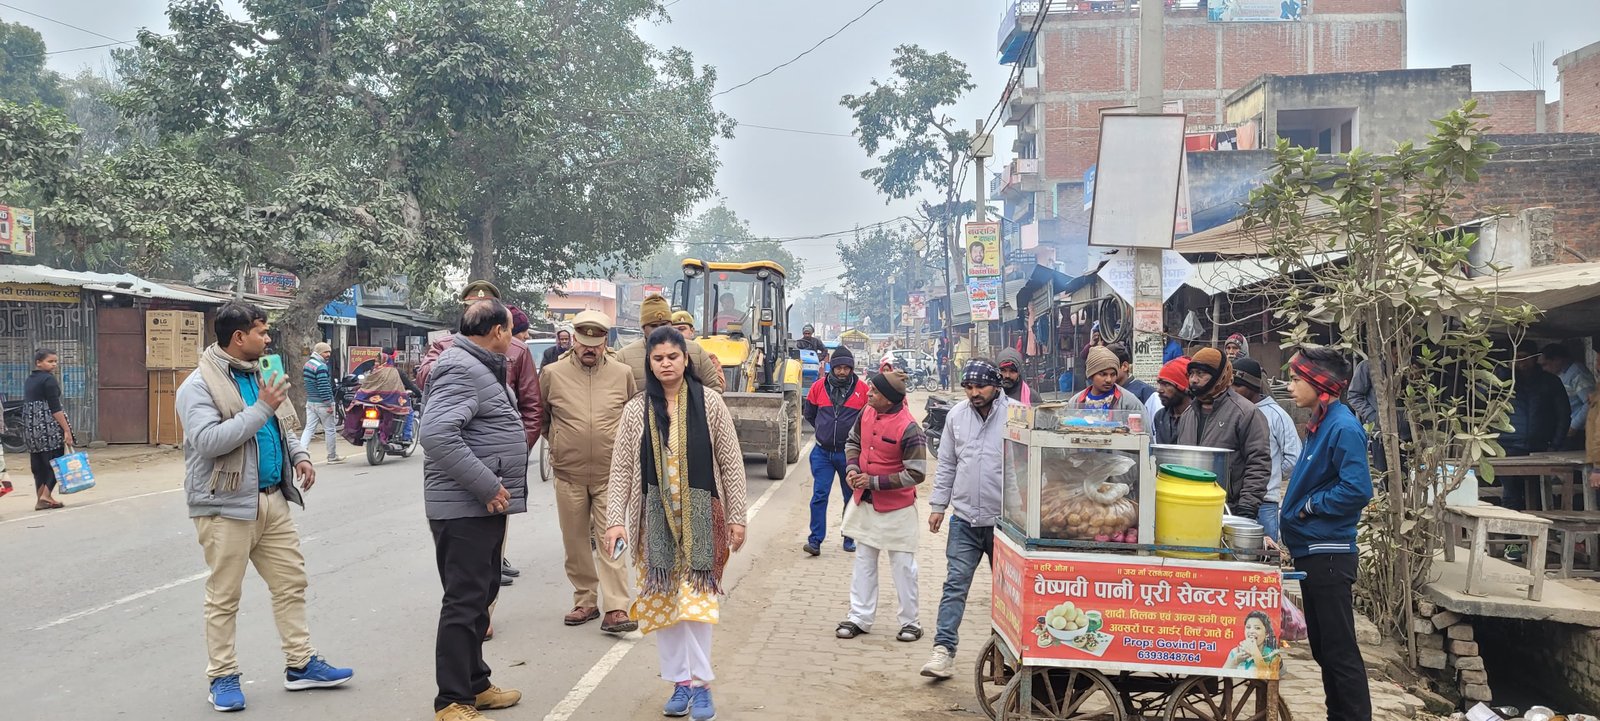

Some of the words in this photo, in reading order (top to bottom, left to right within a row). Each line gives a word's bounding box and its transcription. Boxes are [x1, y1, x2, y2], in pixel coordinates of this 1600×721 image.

[63, 290, 80, 298] स्टोर
[1040, 563, 1052, 572] हरि
[1124, 568, 1136, 576] जय
[1175, 570, 1191, 579] वाली
[1249, 575, 1261, 583] हरि
[1034, 573, 1089, 598] वैष्णवी
[1094, 578, 1135, 600] पानी
[1140, 580, 1172, 606] पूरी
[1177, 582, 1230, 606] सेन्टर
[1130, 609, 1157, 620] तिलक
[1160, 611, 1171, 621] एवं
[1174, 613, 1195, 622] अन्य
[1198, 613, 1217, 624] सभी
[1220, 616, 1236, 626] शुभ
[1109, 622, 1140, 633] अवसरों
[1142, 625, 1154, 634] पर
[1184, 626, 1201, 637] लिए
[1204, 628, 1222, 638] जाते
[1123, 637, 1153, 648] Prop:
[1156, 639, 1196, 650] Govind
[1199, 641, 1216, 651] Pal
[1138, 650, 1201, 662] 6393848764
